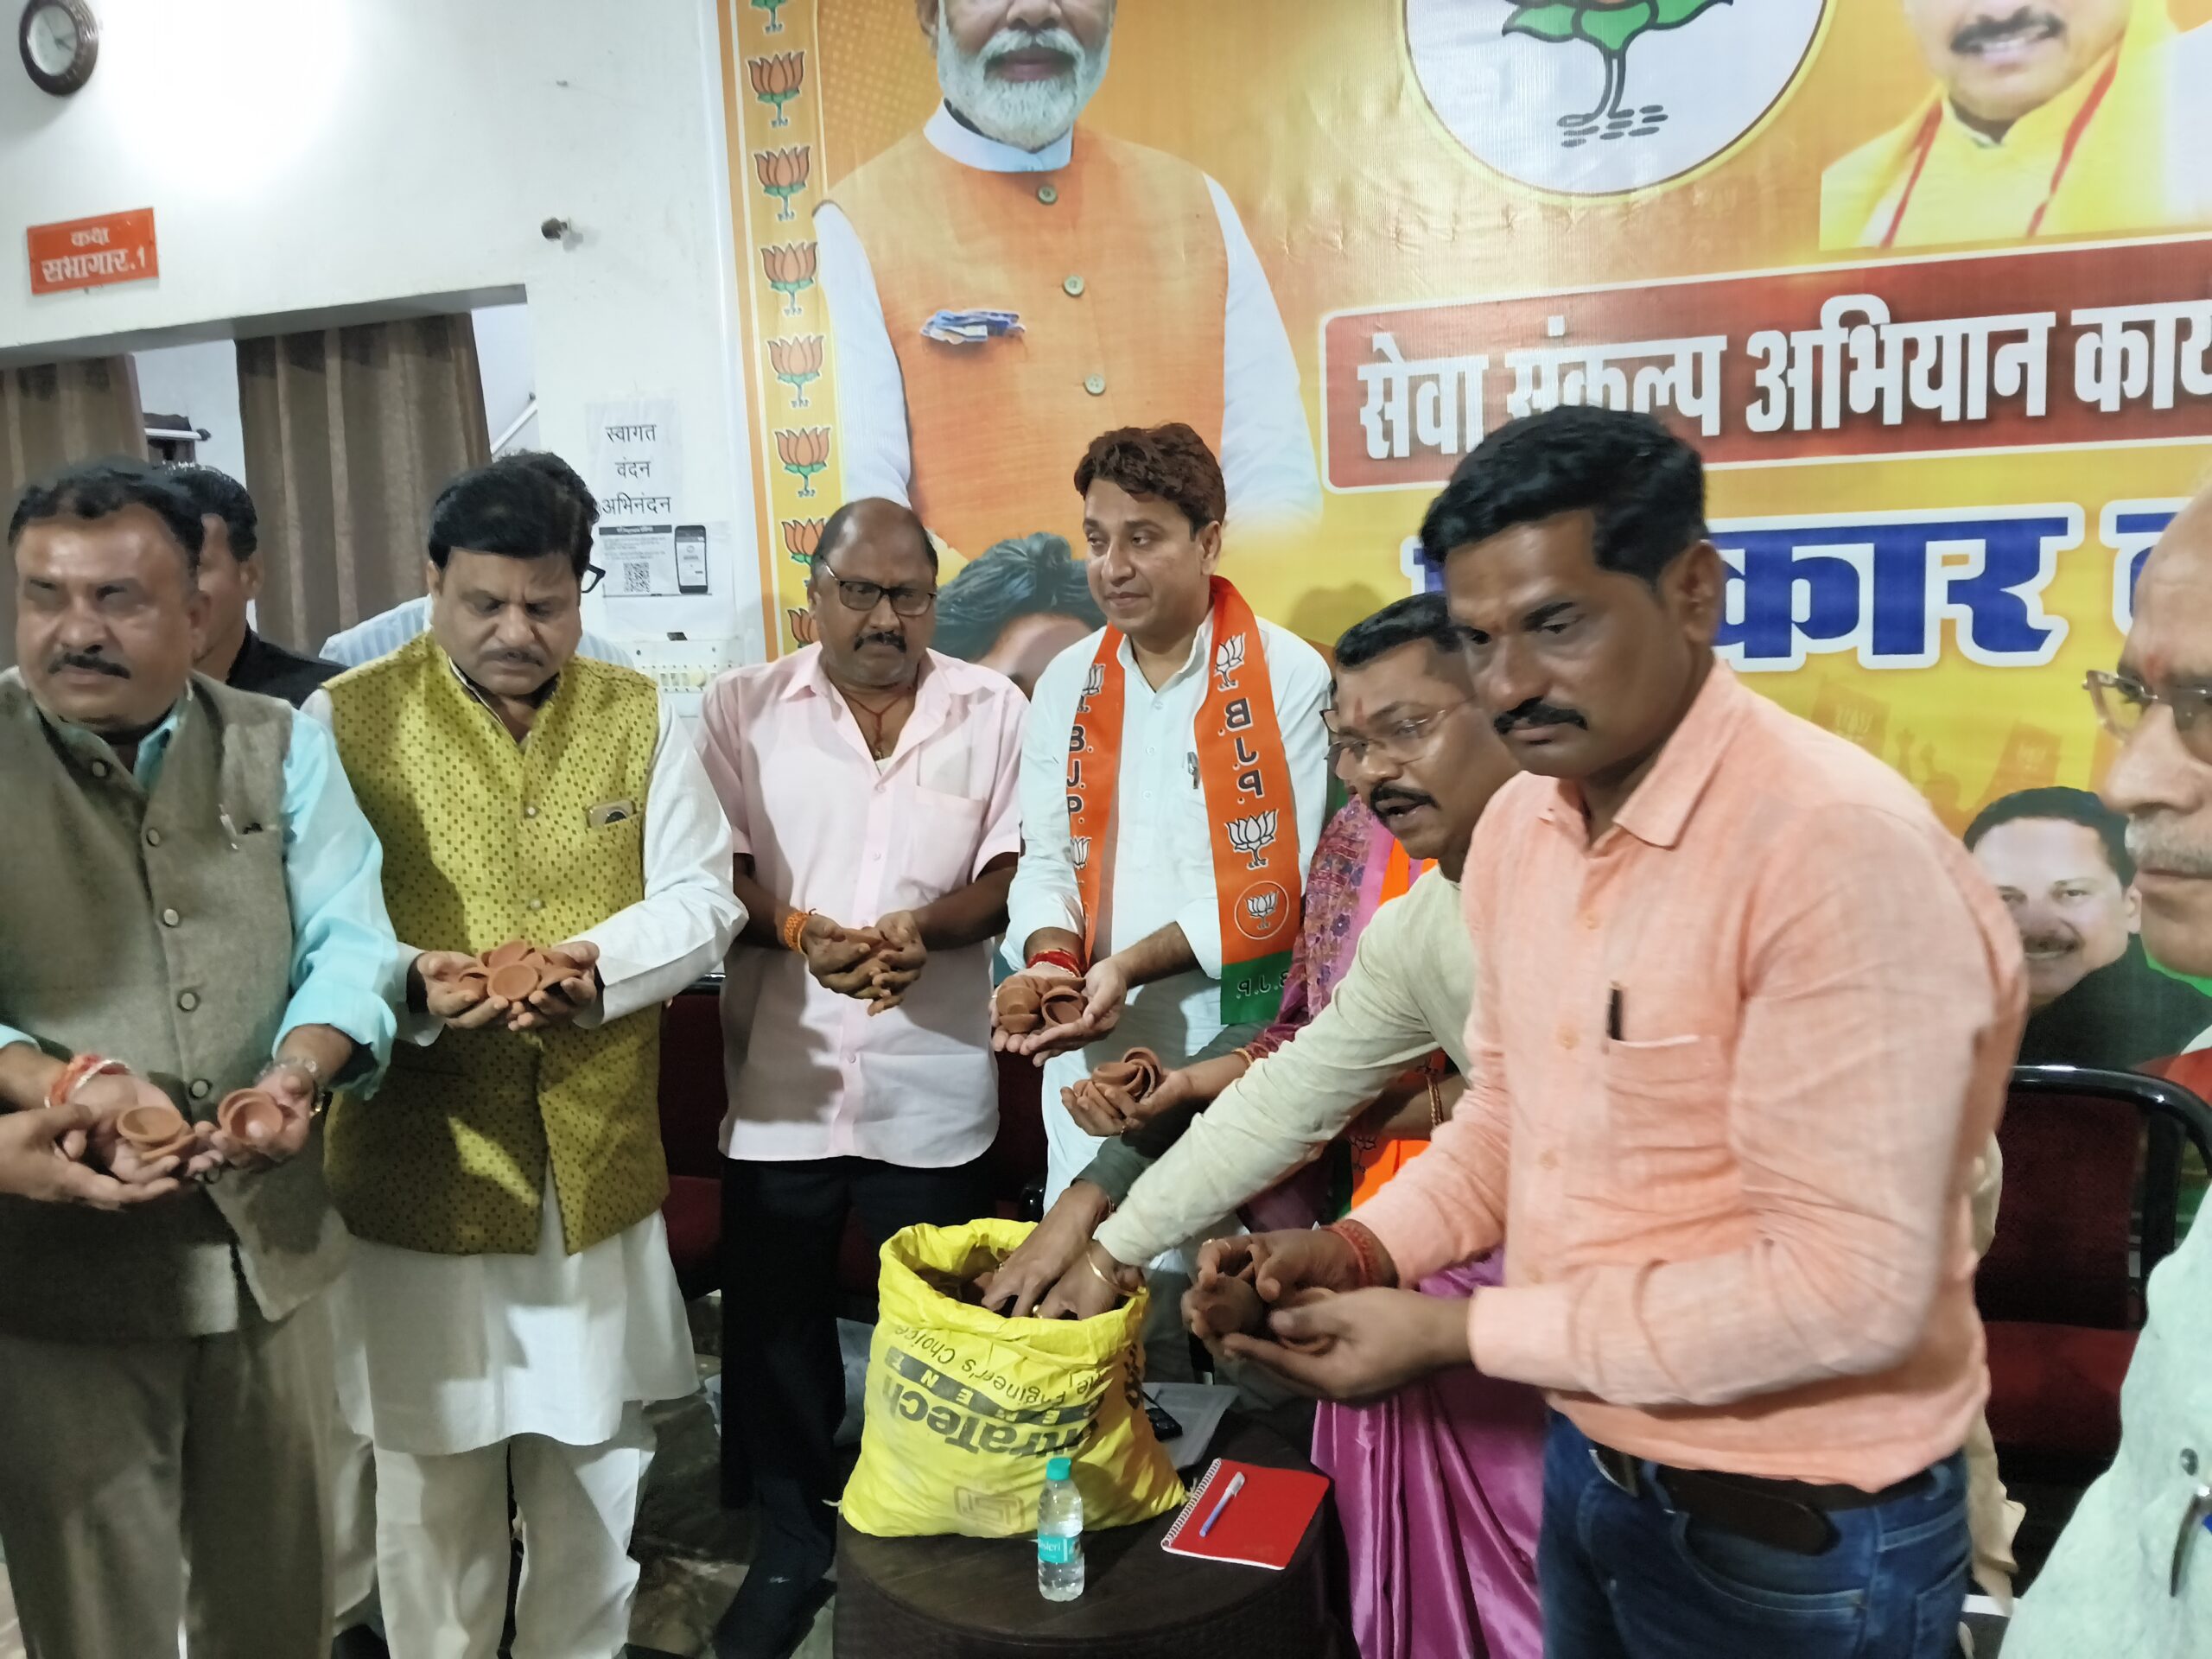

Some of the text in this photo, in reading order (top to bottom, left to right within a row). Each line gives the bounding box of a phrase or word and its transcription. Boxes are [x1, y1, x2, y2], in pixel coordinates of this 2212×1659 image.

[1357, 332, 1490, 460] सेवा
[1745, 294, 2056, 432] अभियान
[605, 424, 657, 442] स्वागत
[615, 456, 651, 478] वंदन
[602, 492, 671, 514] अभिनंदन
[895, 1325, 957, 1365] Choice
[882, 1374, 1092, 1460] ltraTech
